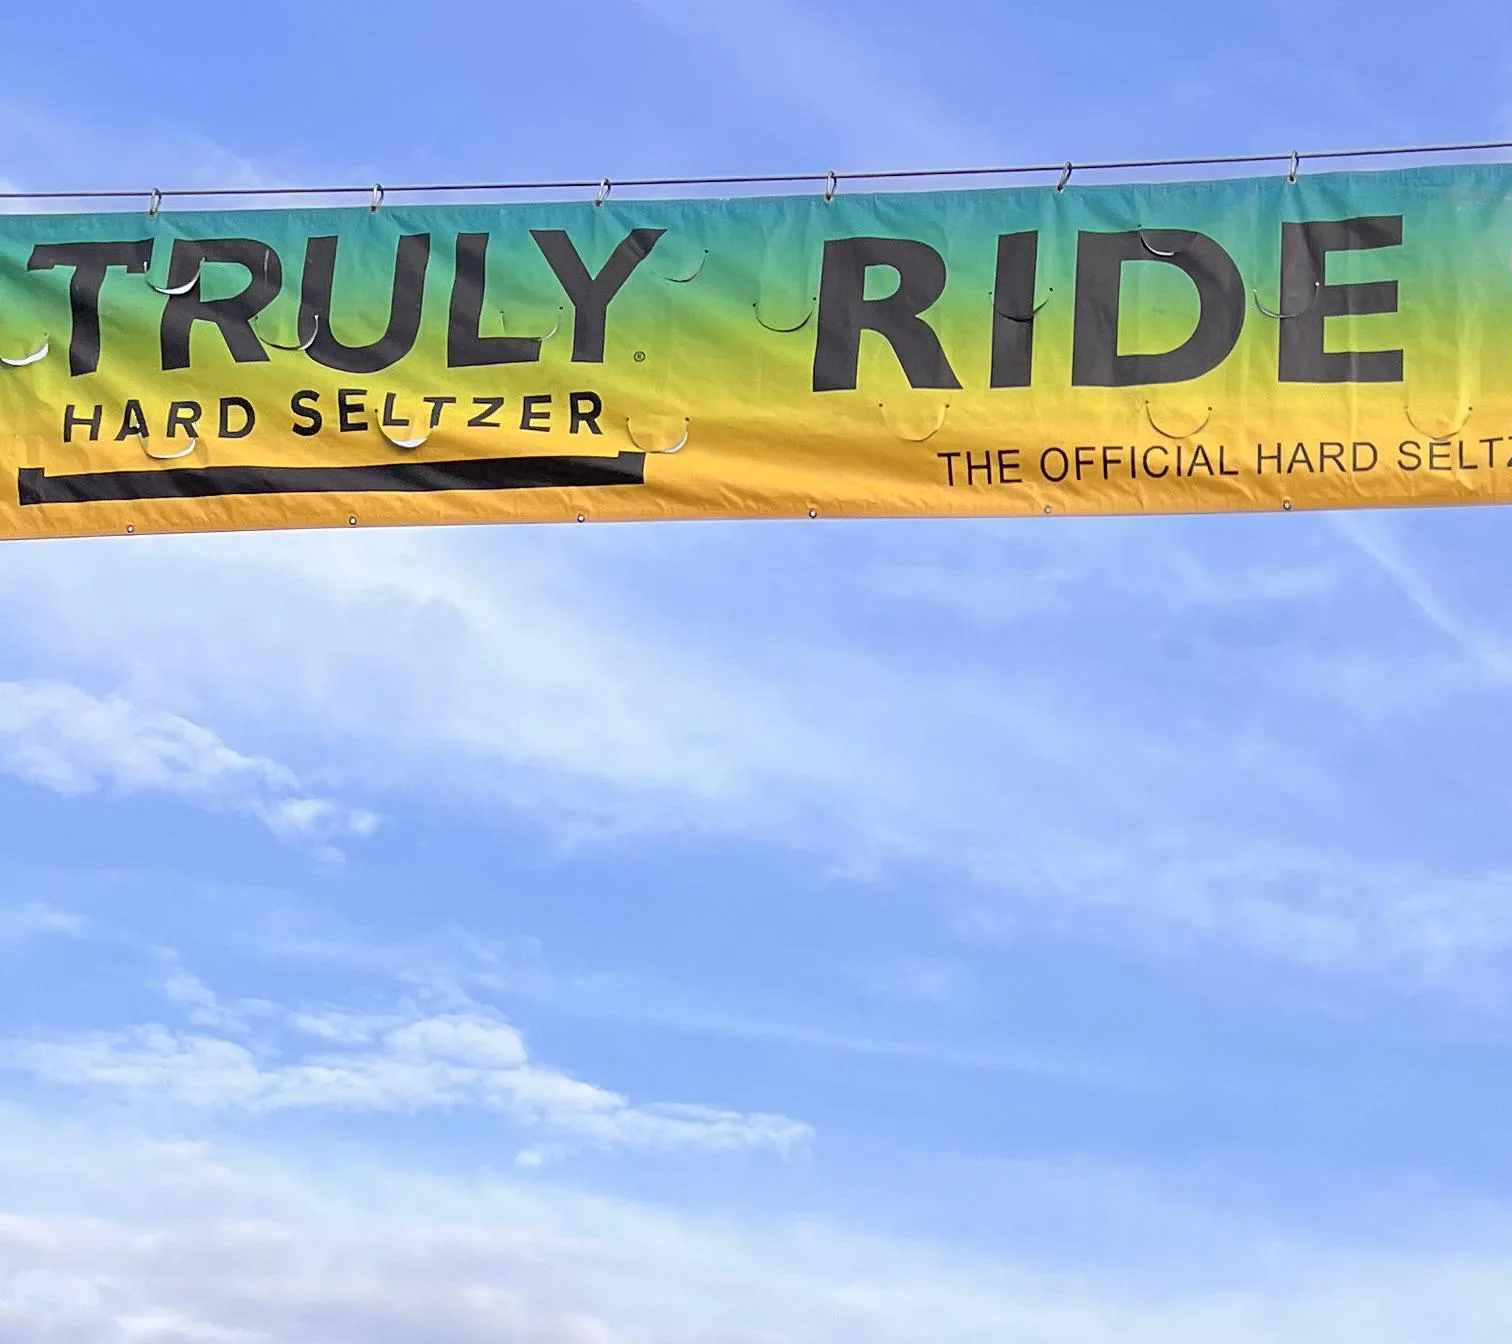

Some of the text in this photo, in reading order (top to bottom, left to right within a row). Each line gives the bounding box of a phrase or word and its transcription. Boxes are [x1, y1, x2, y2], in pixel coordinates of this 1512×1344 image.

[27, 229, 667, 377] TRULY
[812, 215, 1404, 392] RIDE
[64, 389, 603, 442] HARD SELTZER
[937, 449, 1022, 487] THE
[1040, 444, 1239, 484] OFFICIAL
[1257, 441, 1379, 474] HARD
